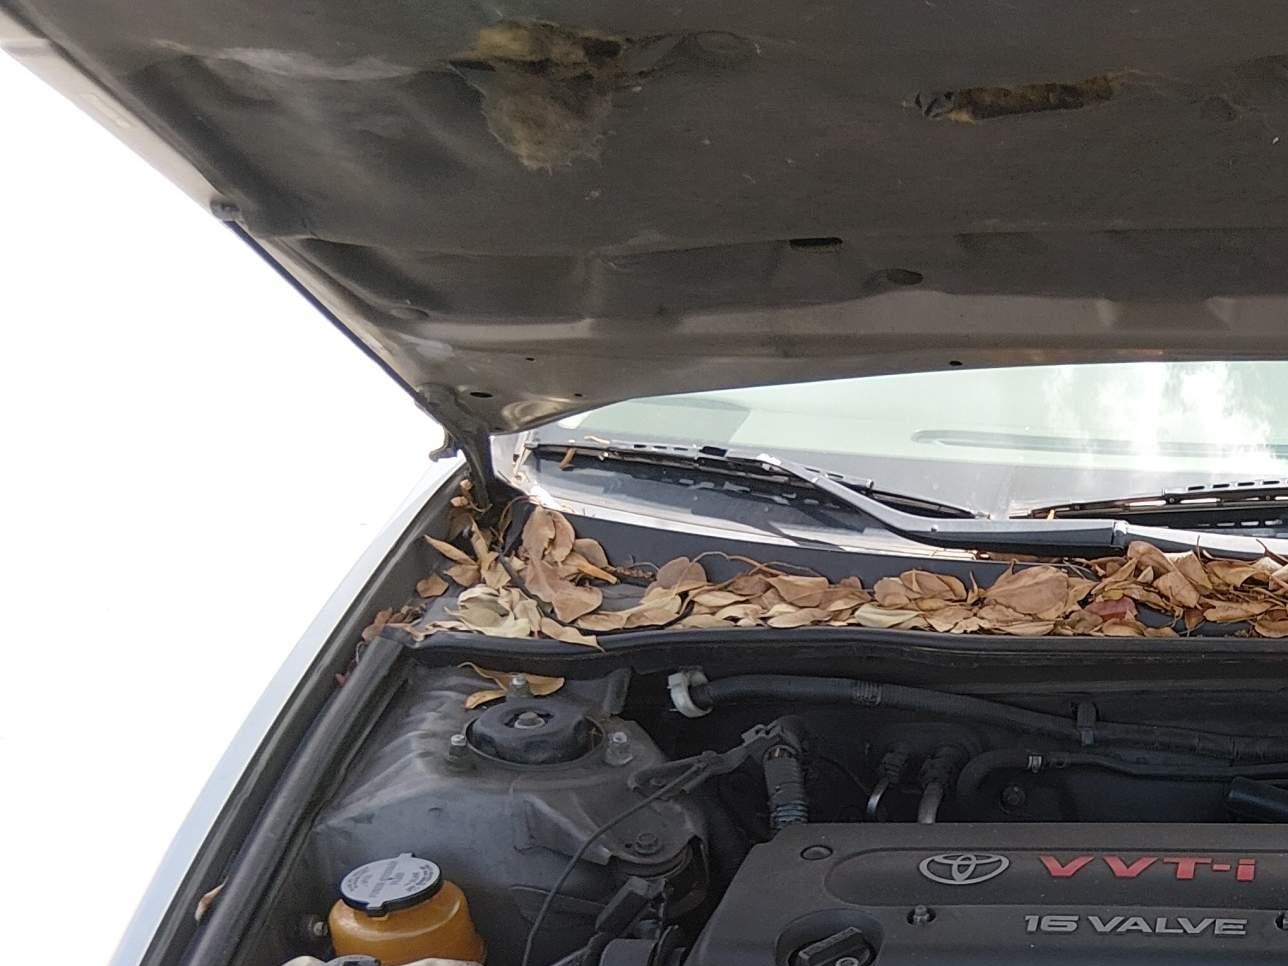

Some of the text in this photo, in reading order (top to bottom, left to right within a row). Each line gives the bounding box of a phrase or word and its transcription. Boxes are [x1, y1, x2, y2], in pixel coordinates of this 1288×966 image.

[1040, 855, 1256, 881] VVT-i
[1025, 914, 1248, 935] 16 VALVE
